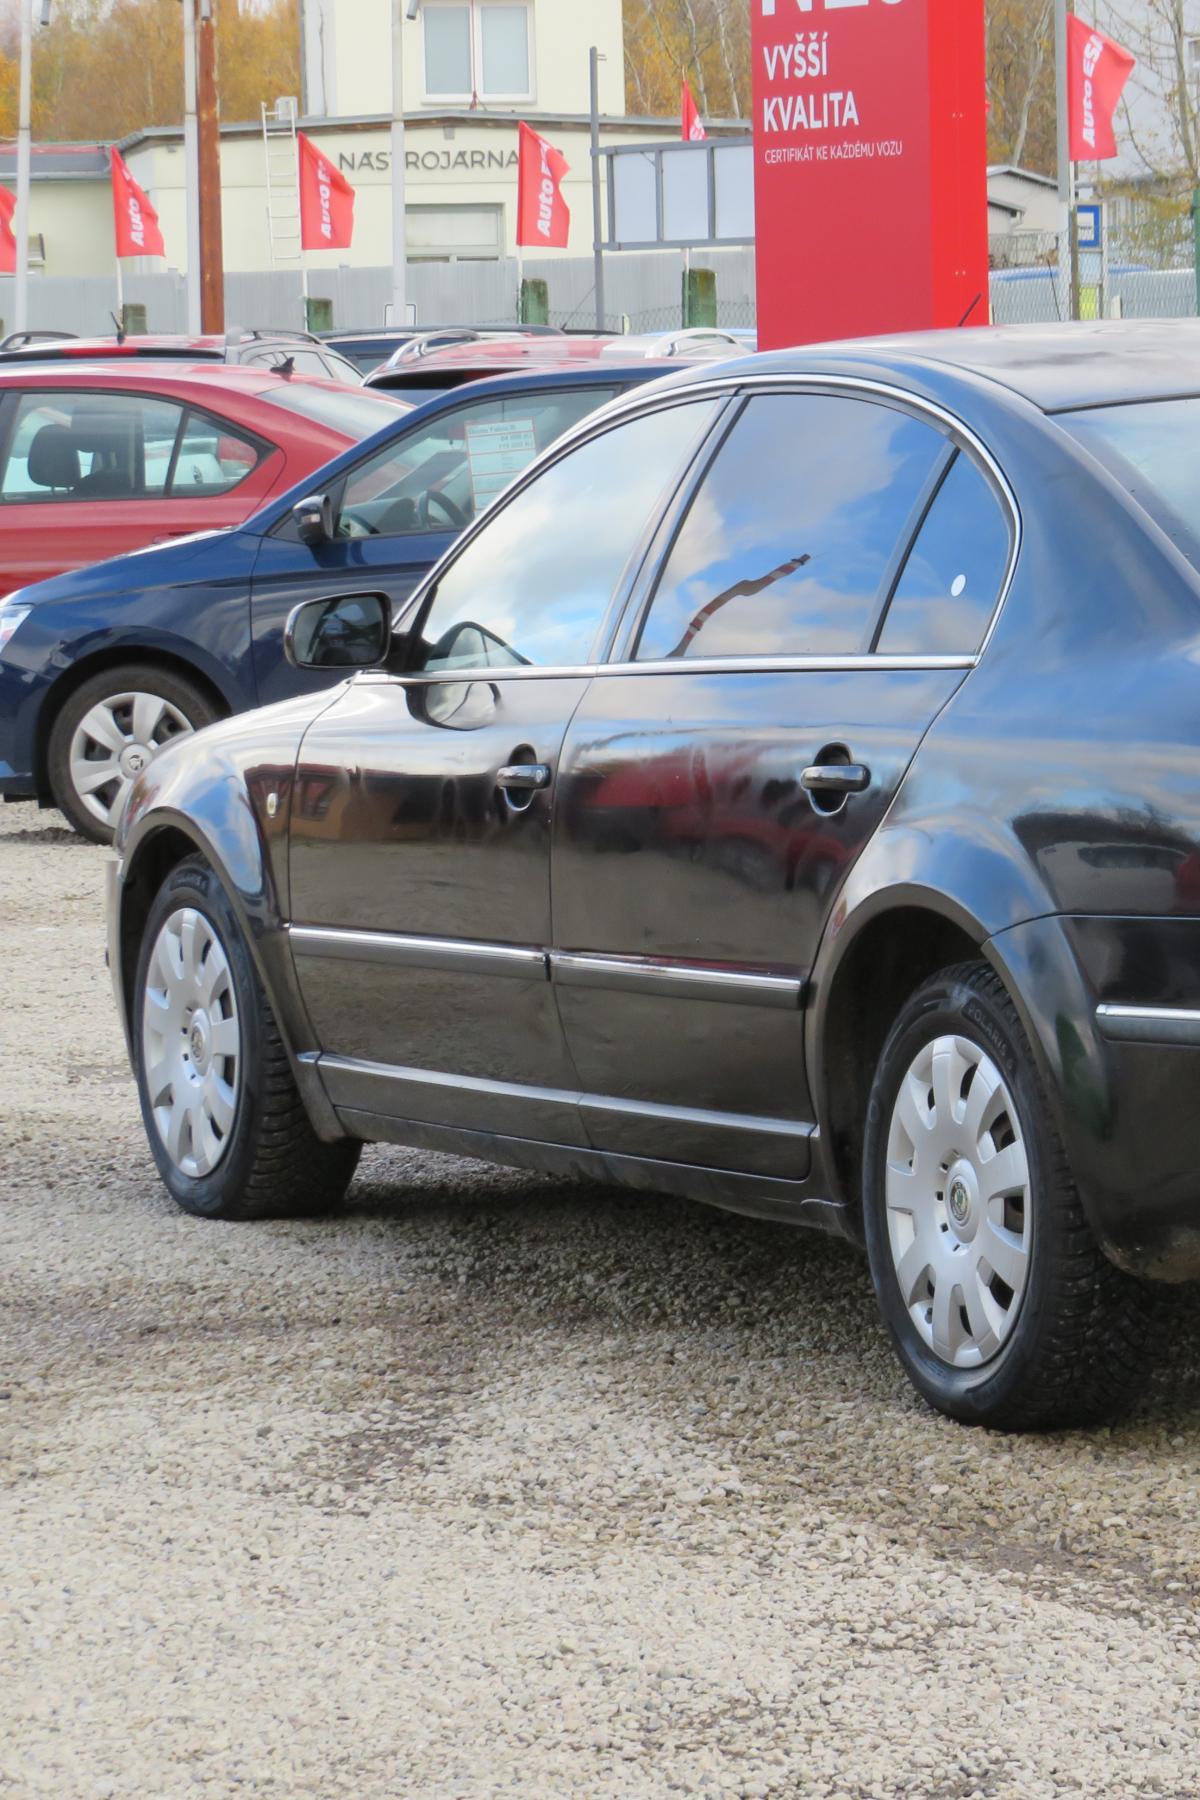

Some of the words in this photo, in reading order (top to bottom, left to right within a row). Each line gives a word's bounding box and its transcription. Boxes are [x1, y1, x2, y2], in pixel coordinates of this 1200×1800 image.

[763, 31, 829, 81] VYŠŠÍ
[763, 91, 860, 133] KVALITA
[1082, 79, 1096, 149] Auto
[338, 150, 520, 172] NÁSROJÁRNA
[764, 143, 815, 165] CERTIFIKÁT
[816, 145, 829, 161] KE
[830, 140, 875, 160] KAŽDÉMU
[876, 140, 903, 157] VOZU
[127, 197, 145, 248] Auto
[319, 184, 332, 240] Auto
[536, 178, 554, 239] Auto
